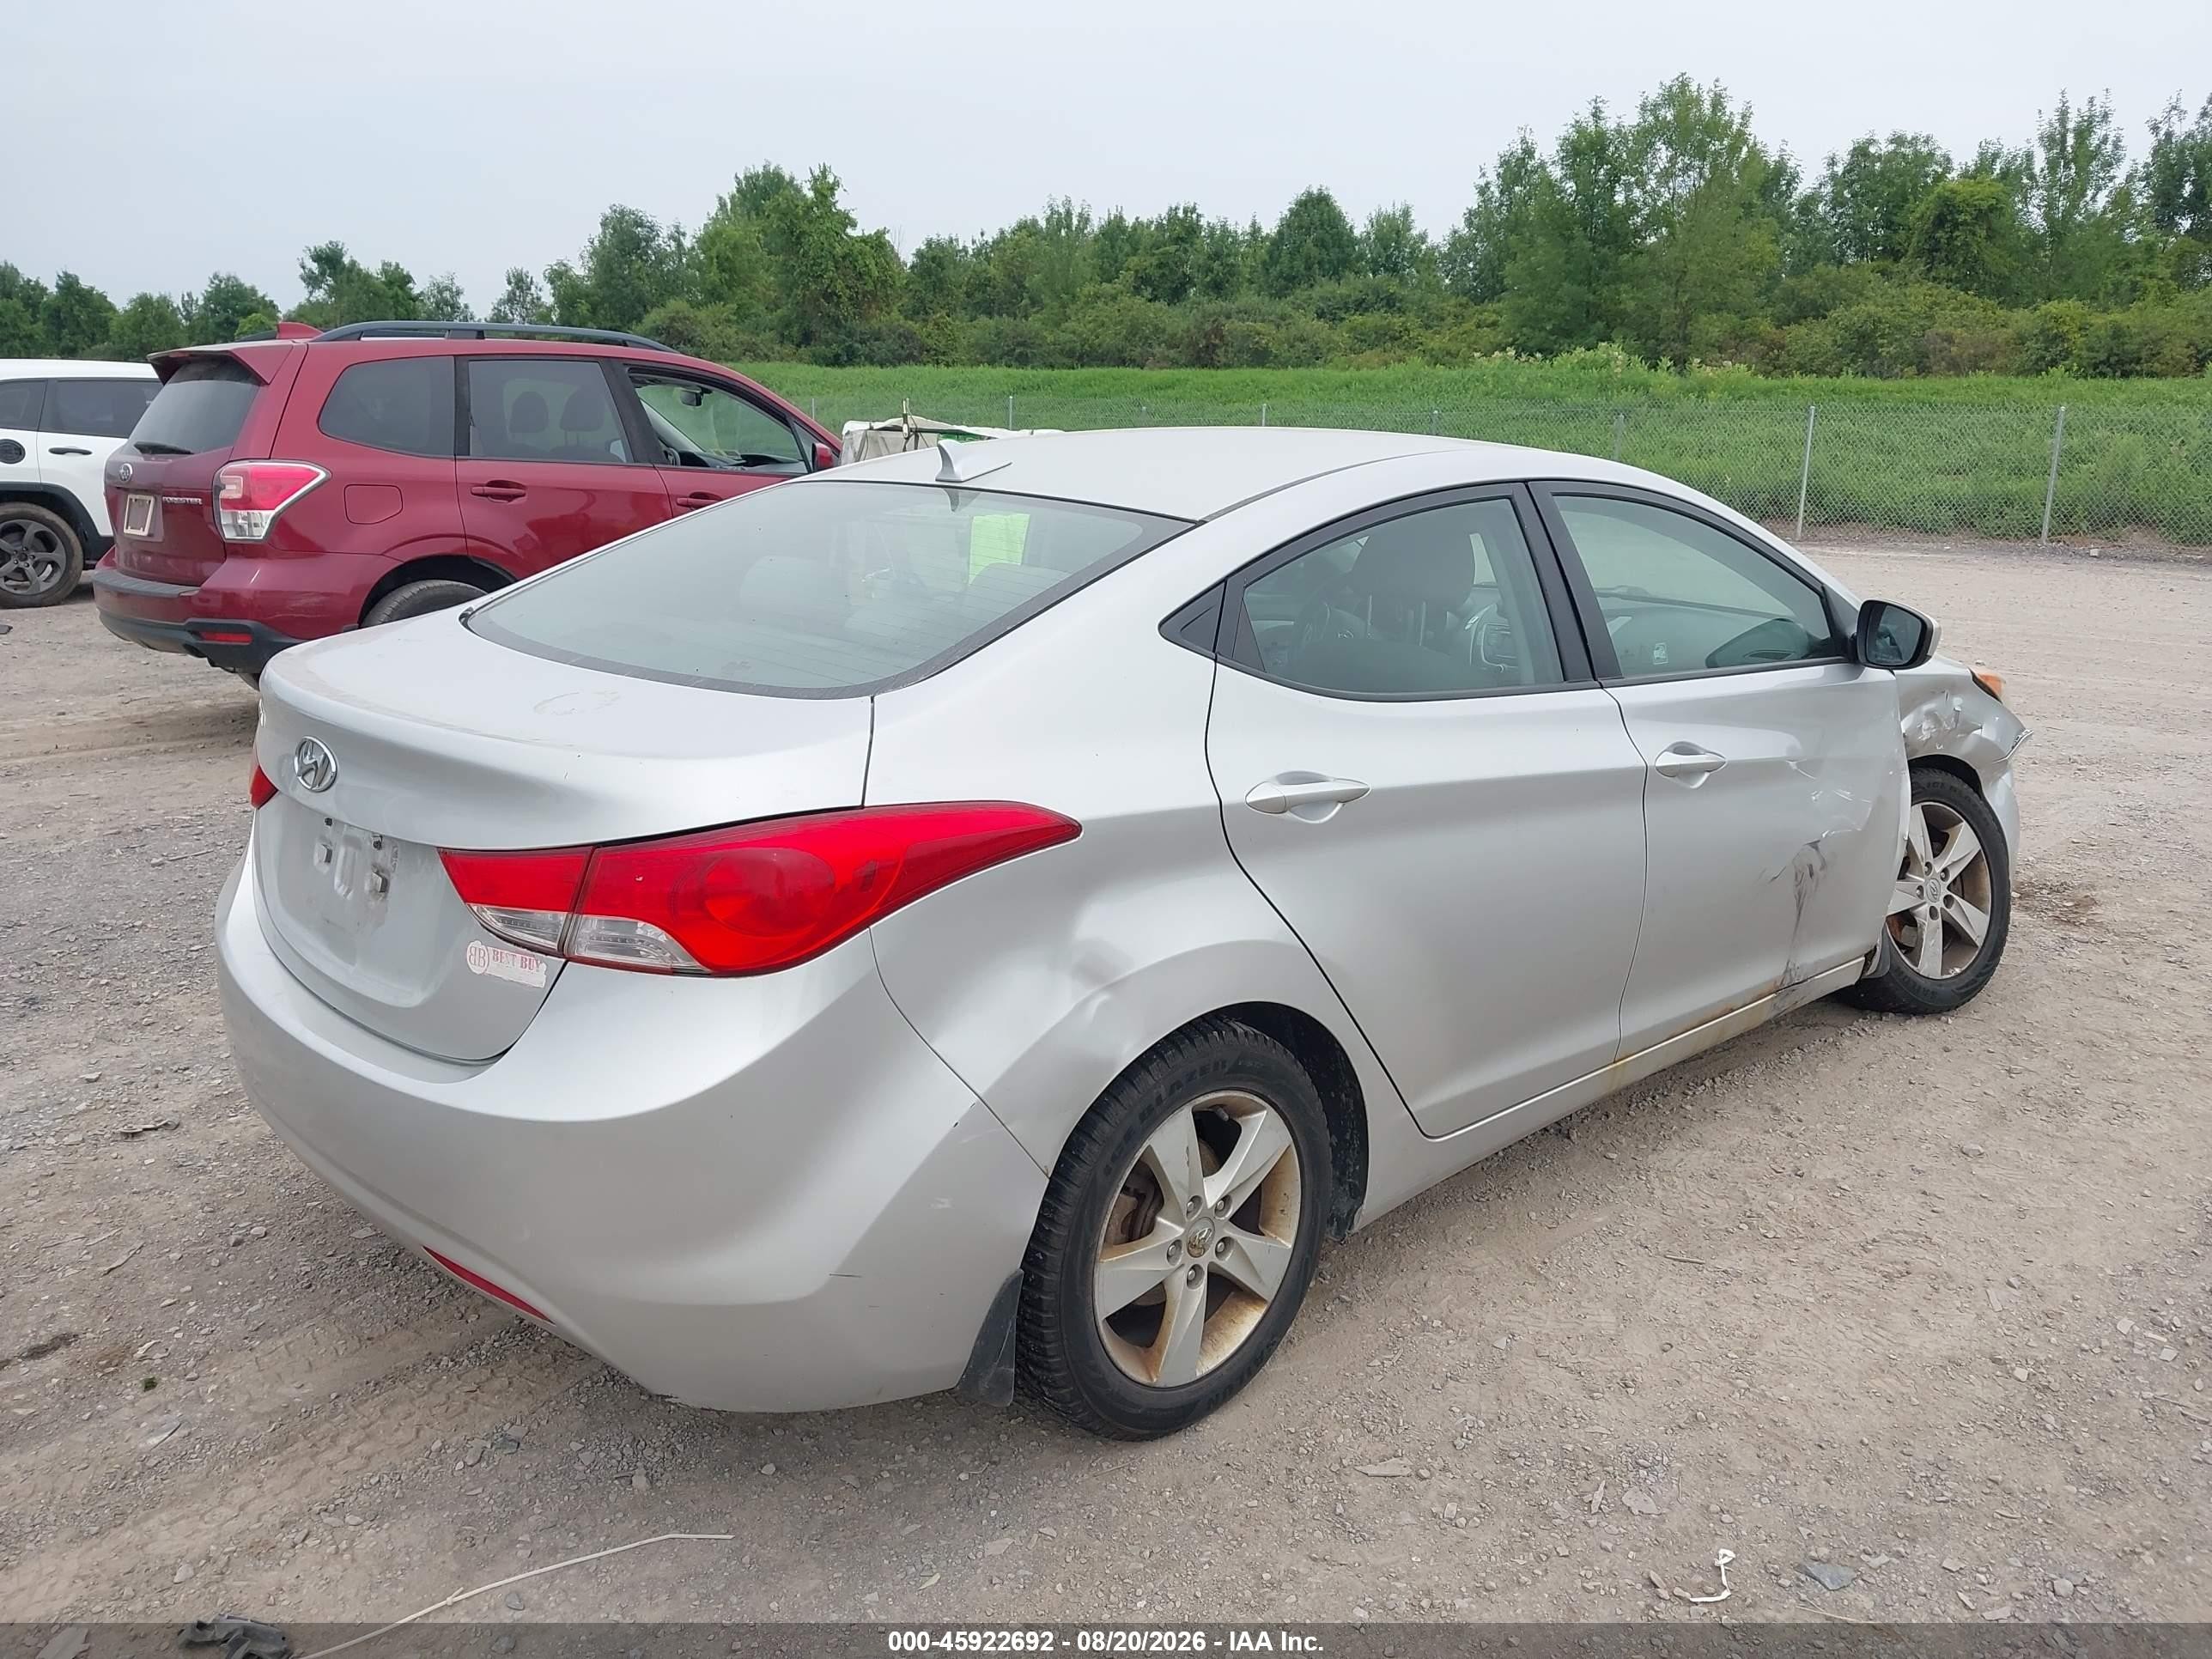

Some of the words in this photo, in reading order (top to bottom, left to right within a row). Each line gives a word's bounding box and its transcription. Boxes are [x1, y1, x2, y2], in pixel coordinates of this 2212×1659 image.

[162, 496, 203, 505] FORESTER
[492, 949, 517, 967] BEST
[520, 956, 542, 972] BUY
